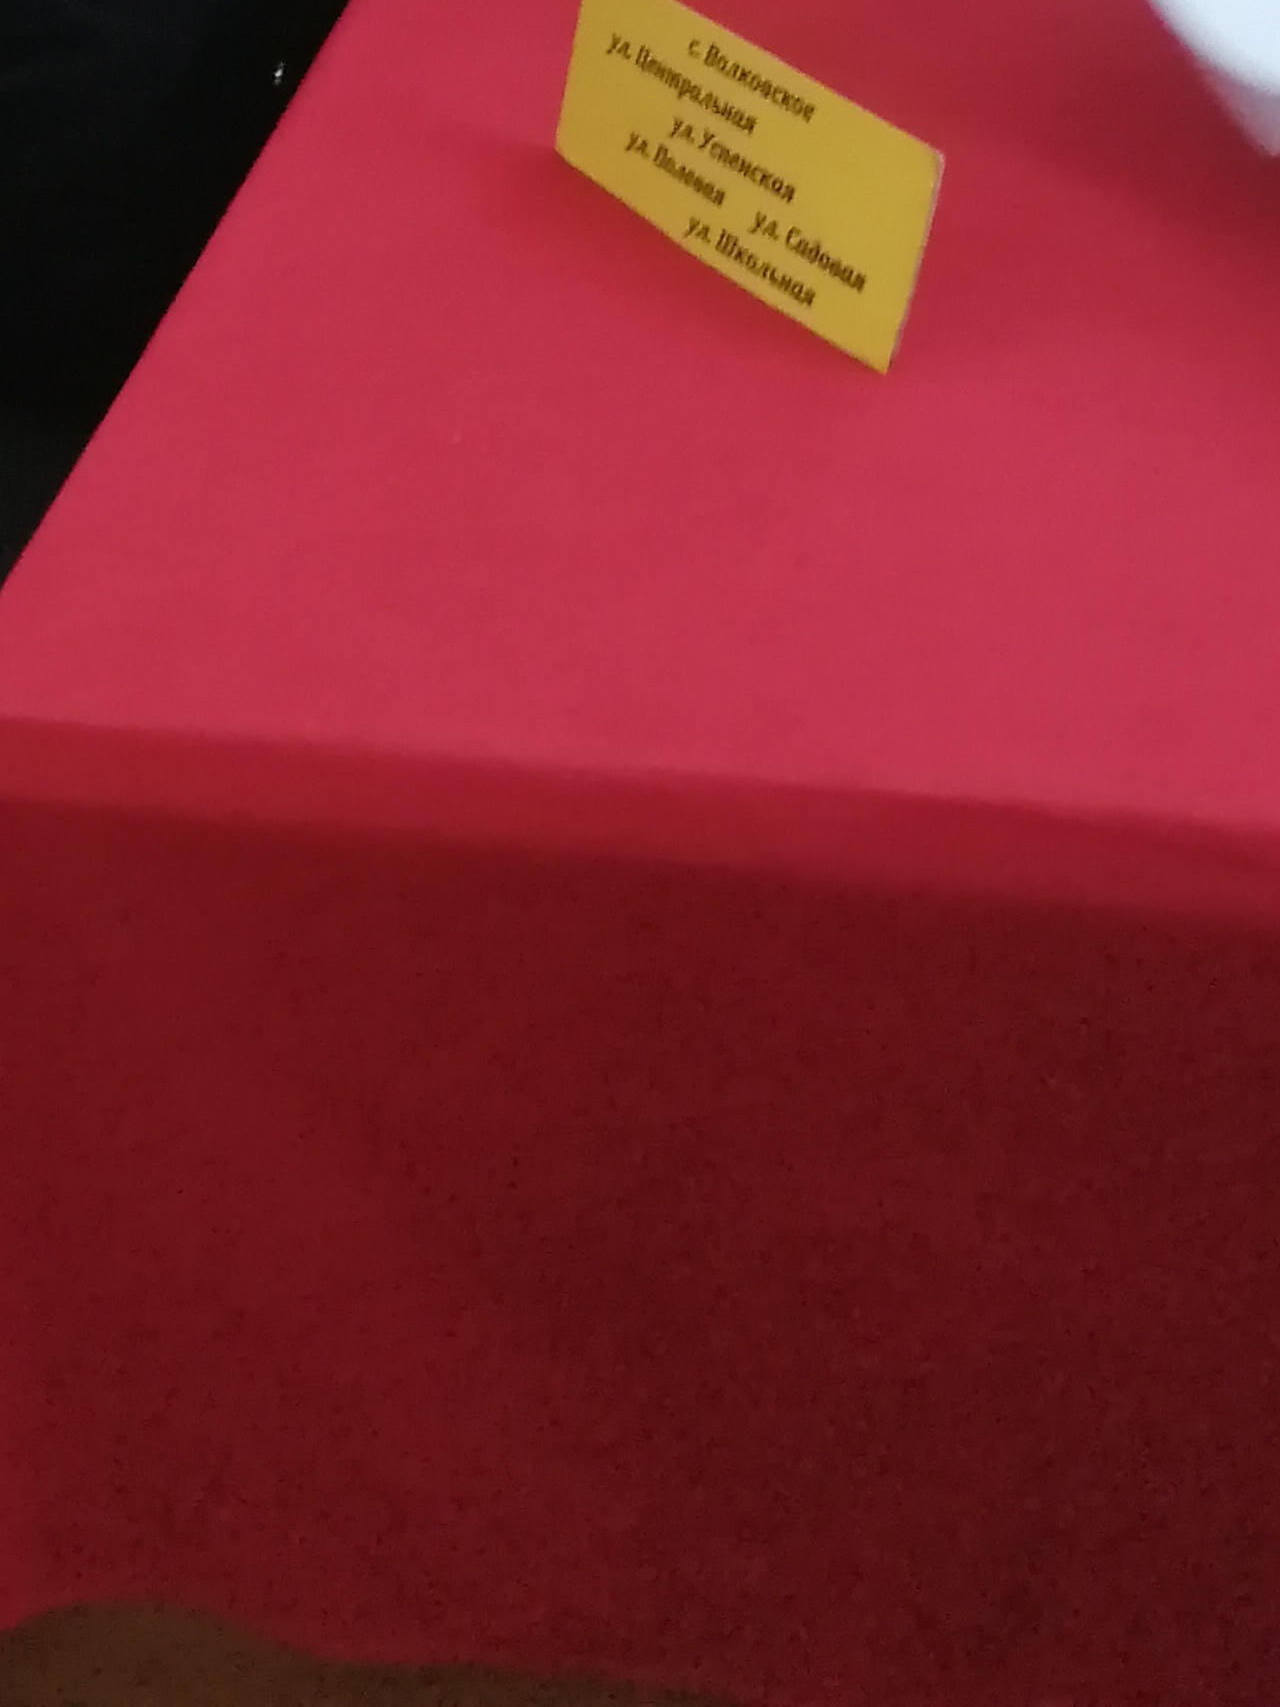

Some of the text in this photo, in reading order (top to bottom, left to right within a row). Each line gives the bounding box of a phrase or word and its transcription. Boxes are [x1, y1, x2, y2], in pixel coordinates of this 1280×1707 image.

[606, 33, 756, 133] ул. Центральная
[688, 39, 816, 124] с. Волковское
[668, 116, 796, 204] ул. Успенская
[625, 131, 649, 158] ул.
[748, 211, 779, 241] ул.
[785, 226, 867, 295] Садовая
[685, 217, 816, 307] ул. Школьная
